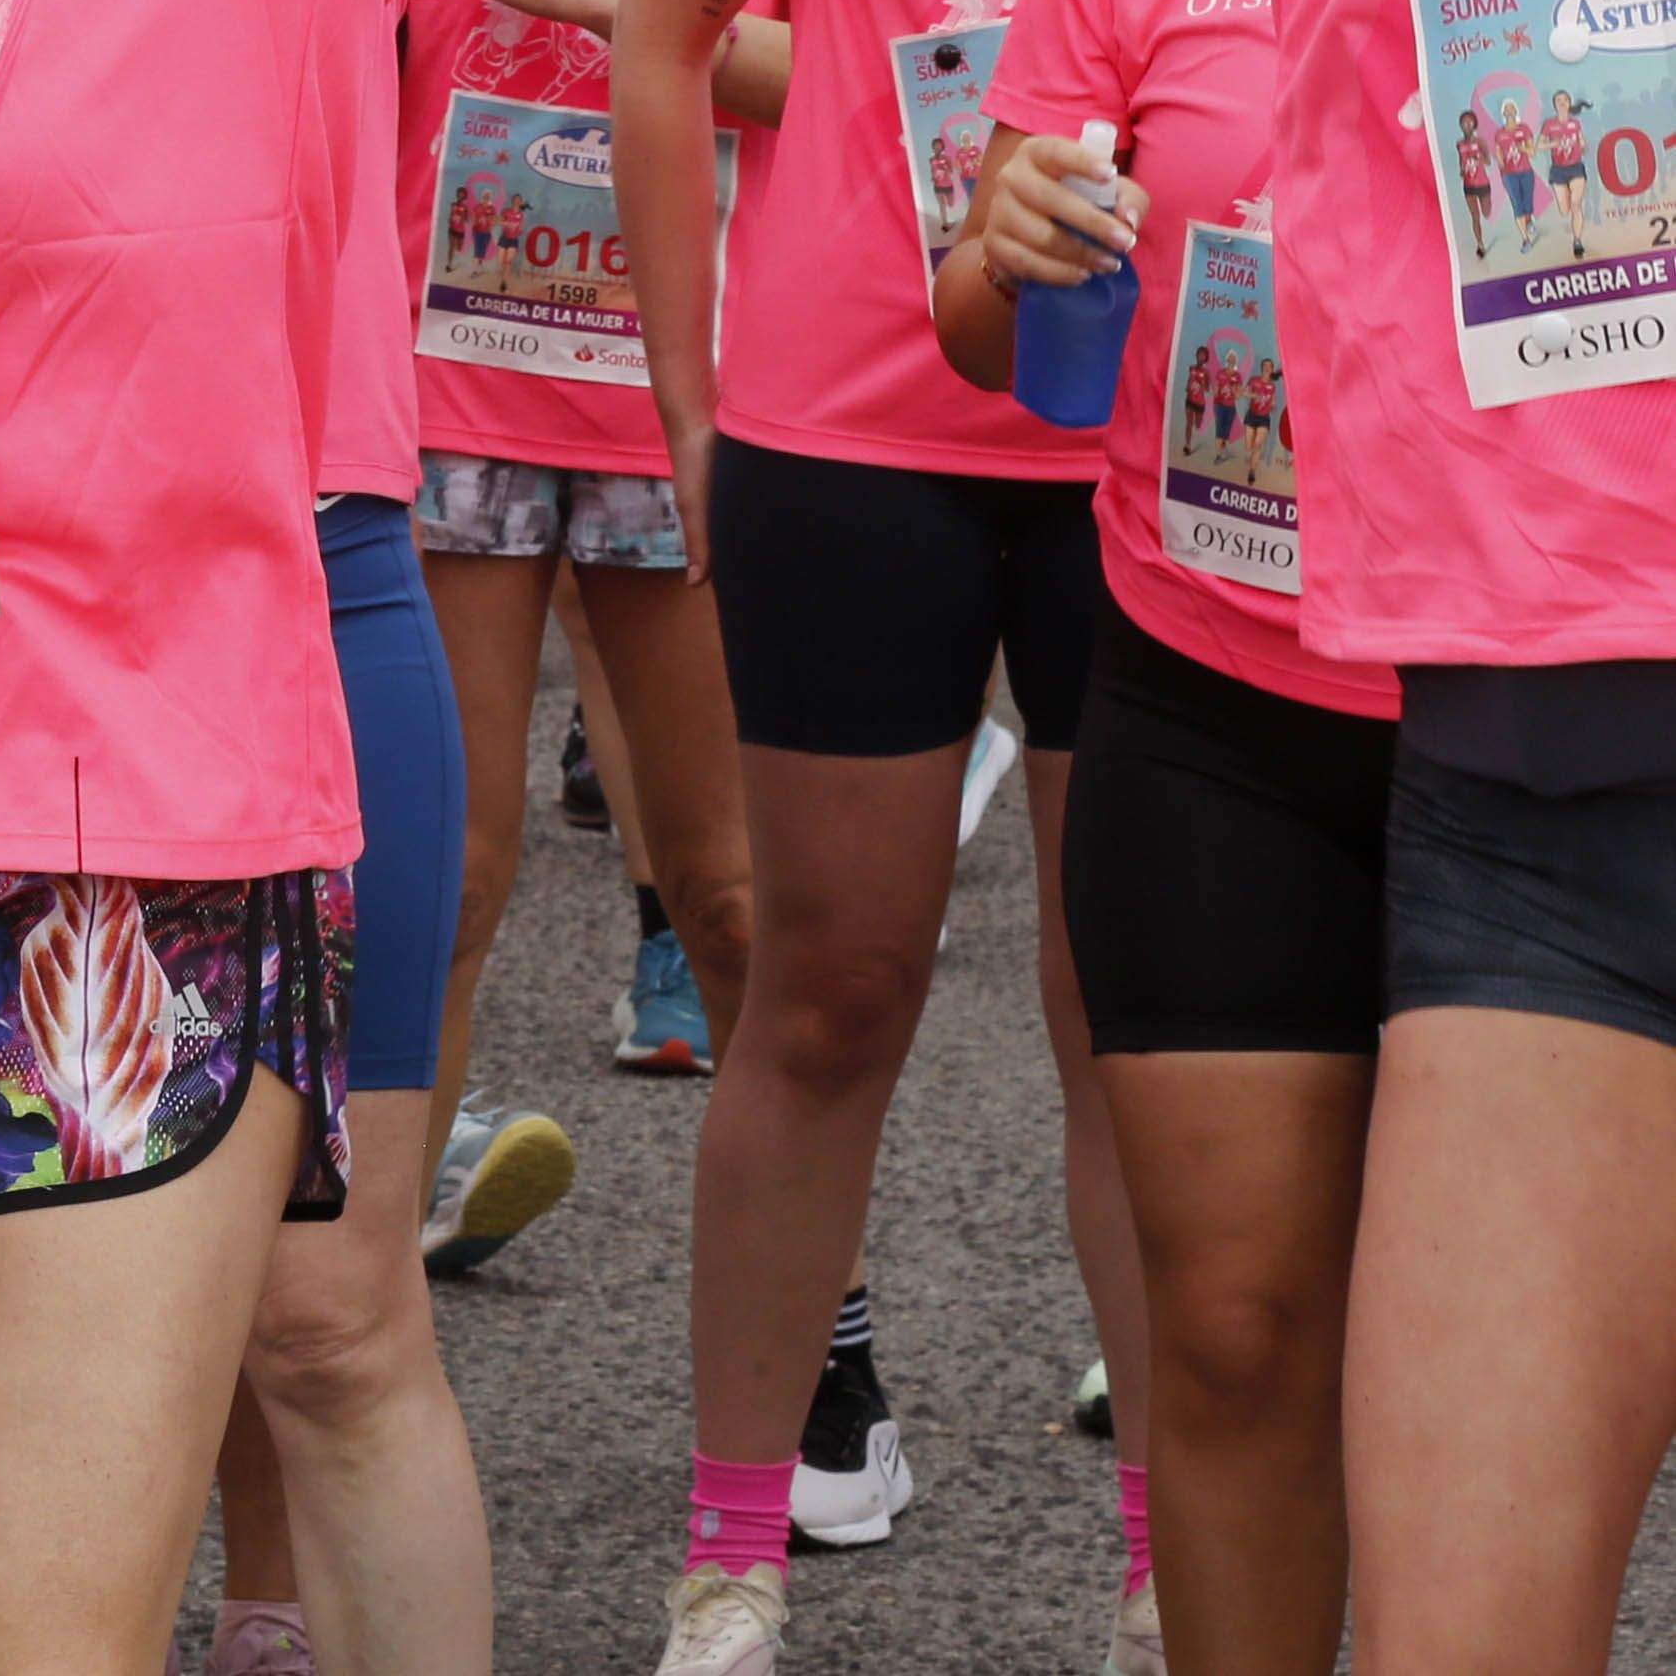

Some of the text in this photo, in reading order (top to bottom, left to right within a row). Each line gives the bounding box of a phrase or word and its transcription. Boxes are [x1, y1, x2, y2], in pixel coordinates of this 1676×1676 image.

[463, 120, 509, 140] SUMA
[525, 225, 630, 277] 016
[1205, 260, 1256, 289] SUMA
[1525, 259, 1668, 305] CARRERA DE
[547, 282, 598, 306] 1598
[465, 295, 528, 318] CARRERA
[532, 307, 550, 321] DE
[554, 308, 572, 325] LA
[575, 311, 625, 330] MUJER
[450, 324, 539, 356] OYSHO
[1518, 315, 1665, 367] OSHO
[1209, 484, 1280, 520] CARRERA
[1193, 522, 1294, 570] OYSHO
